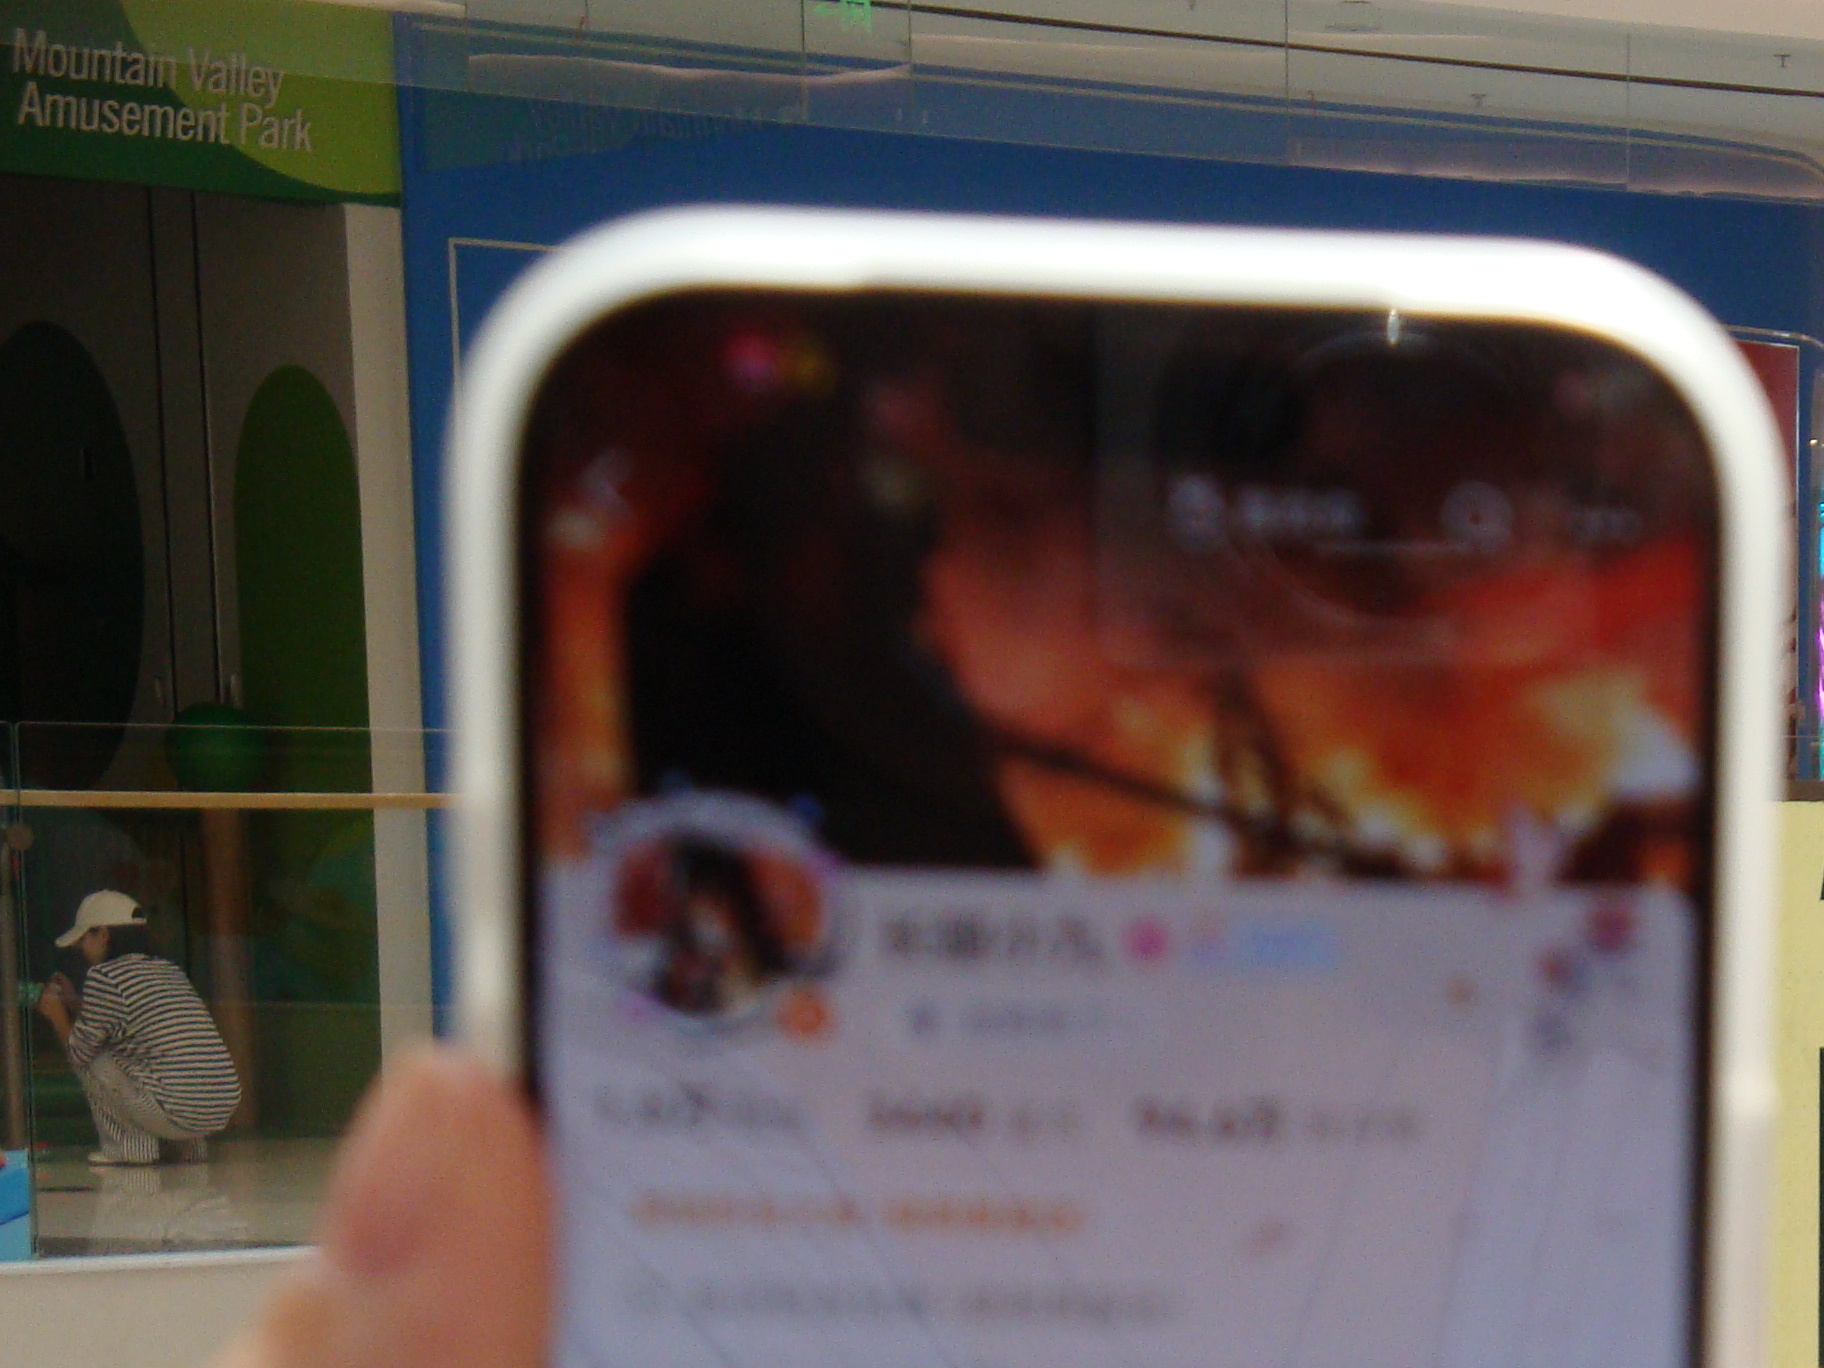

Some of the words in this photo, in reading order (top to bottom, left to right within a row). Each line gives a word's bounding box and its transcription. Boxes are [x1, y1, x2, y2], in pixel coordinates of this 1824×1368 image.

[13, 28, 178, 89] Mountain
[188, 47, 285, 108] Valley
[17, 81, 231, 146] Amusement
[240, 102, 313, 153] Park
